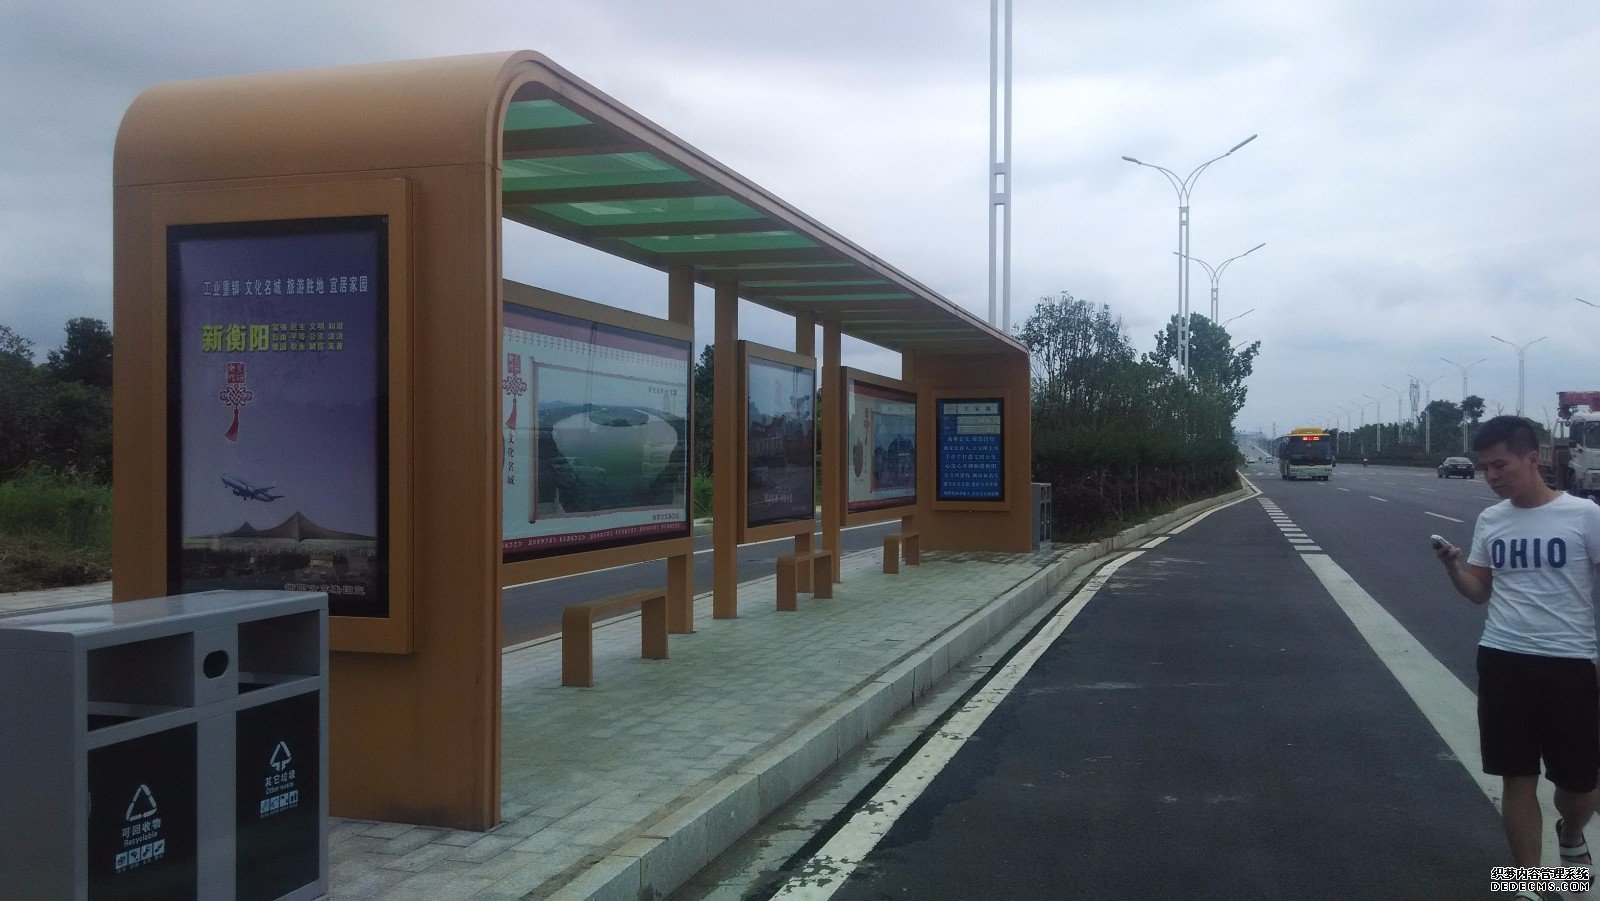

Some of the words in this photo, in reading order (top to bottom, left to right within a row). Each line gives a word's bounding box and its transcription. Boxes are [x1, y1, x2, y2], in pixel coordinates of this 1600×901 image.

[203, 279, 240, 297] 工业重镇
[244, 278, 282, 296] 文化名城
[286, 277, 325, 295] 旅游胜地
[329, 275, 368, 294] 宜居家园
[309, 322, 325, 331] 文明
[202, 323, 270, 352] 新衡阳
[507, 433, 515, 486] 文化名城
[1491, 537, 1567, 569] OHIO
[264, 769, 296, 788] 其它垃圾
[122, 818, 161, 838] 可回收物
[124, 830, 158, 847] Recyclable
